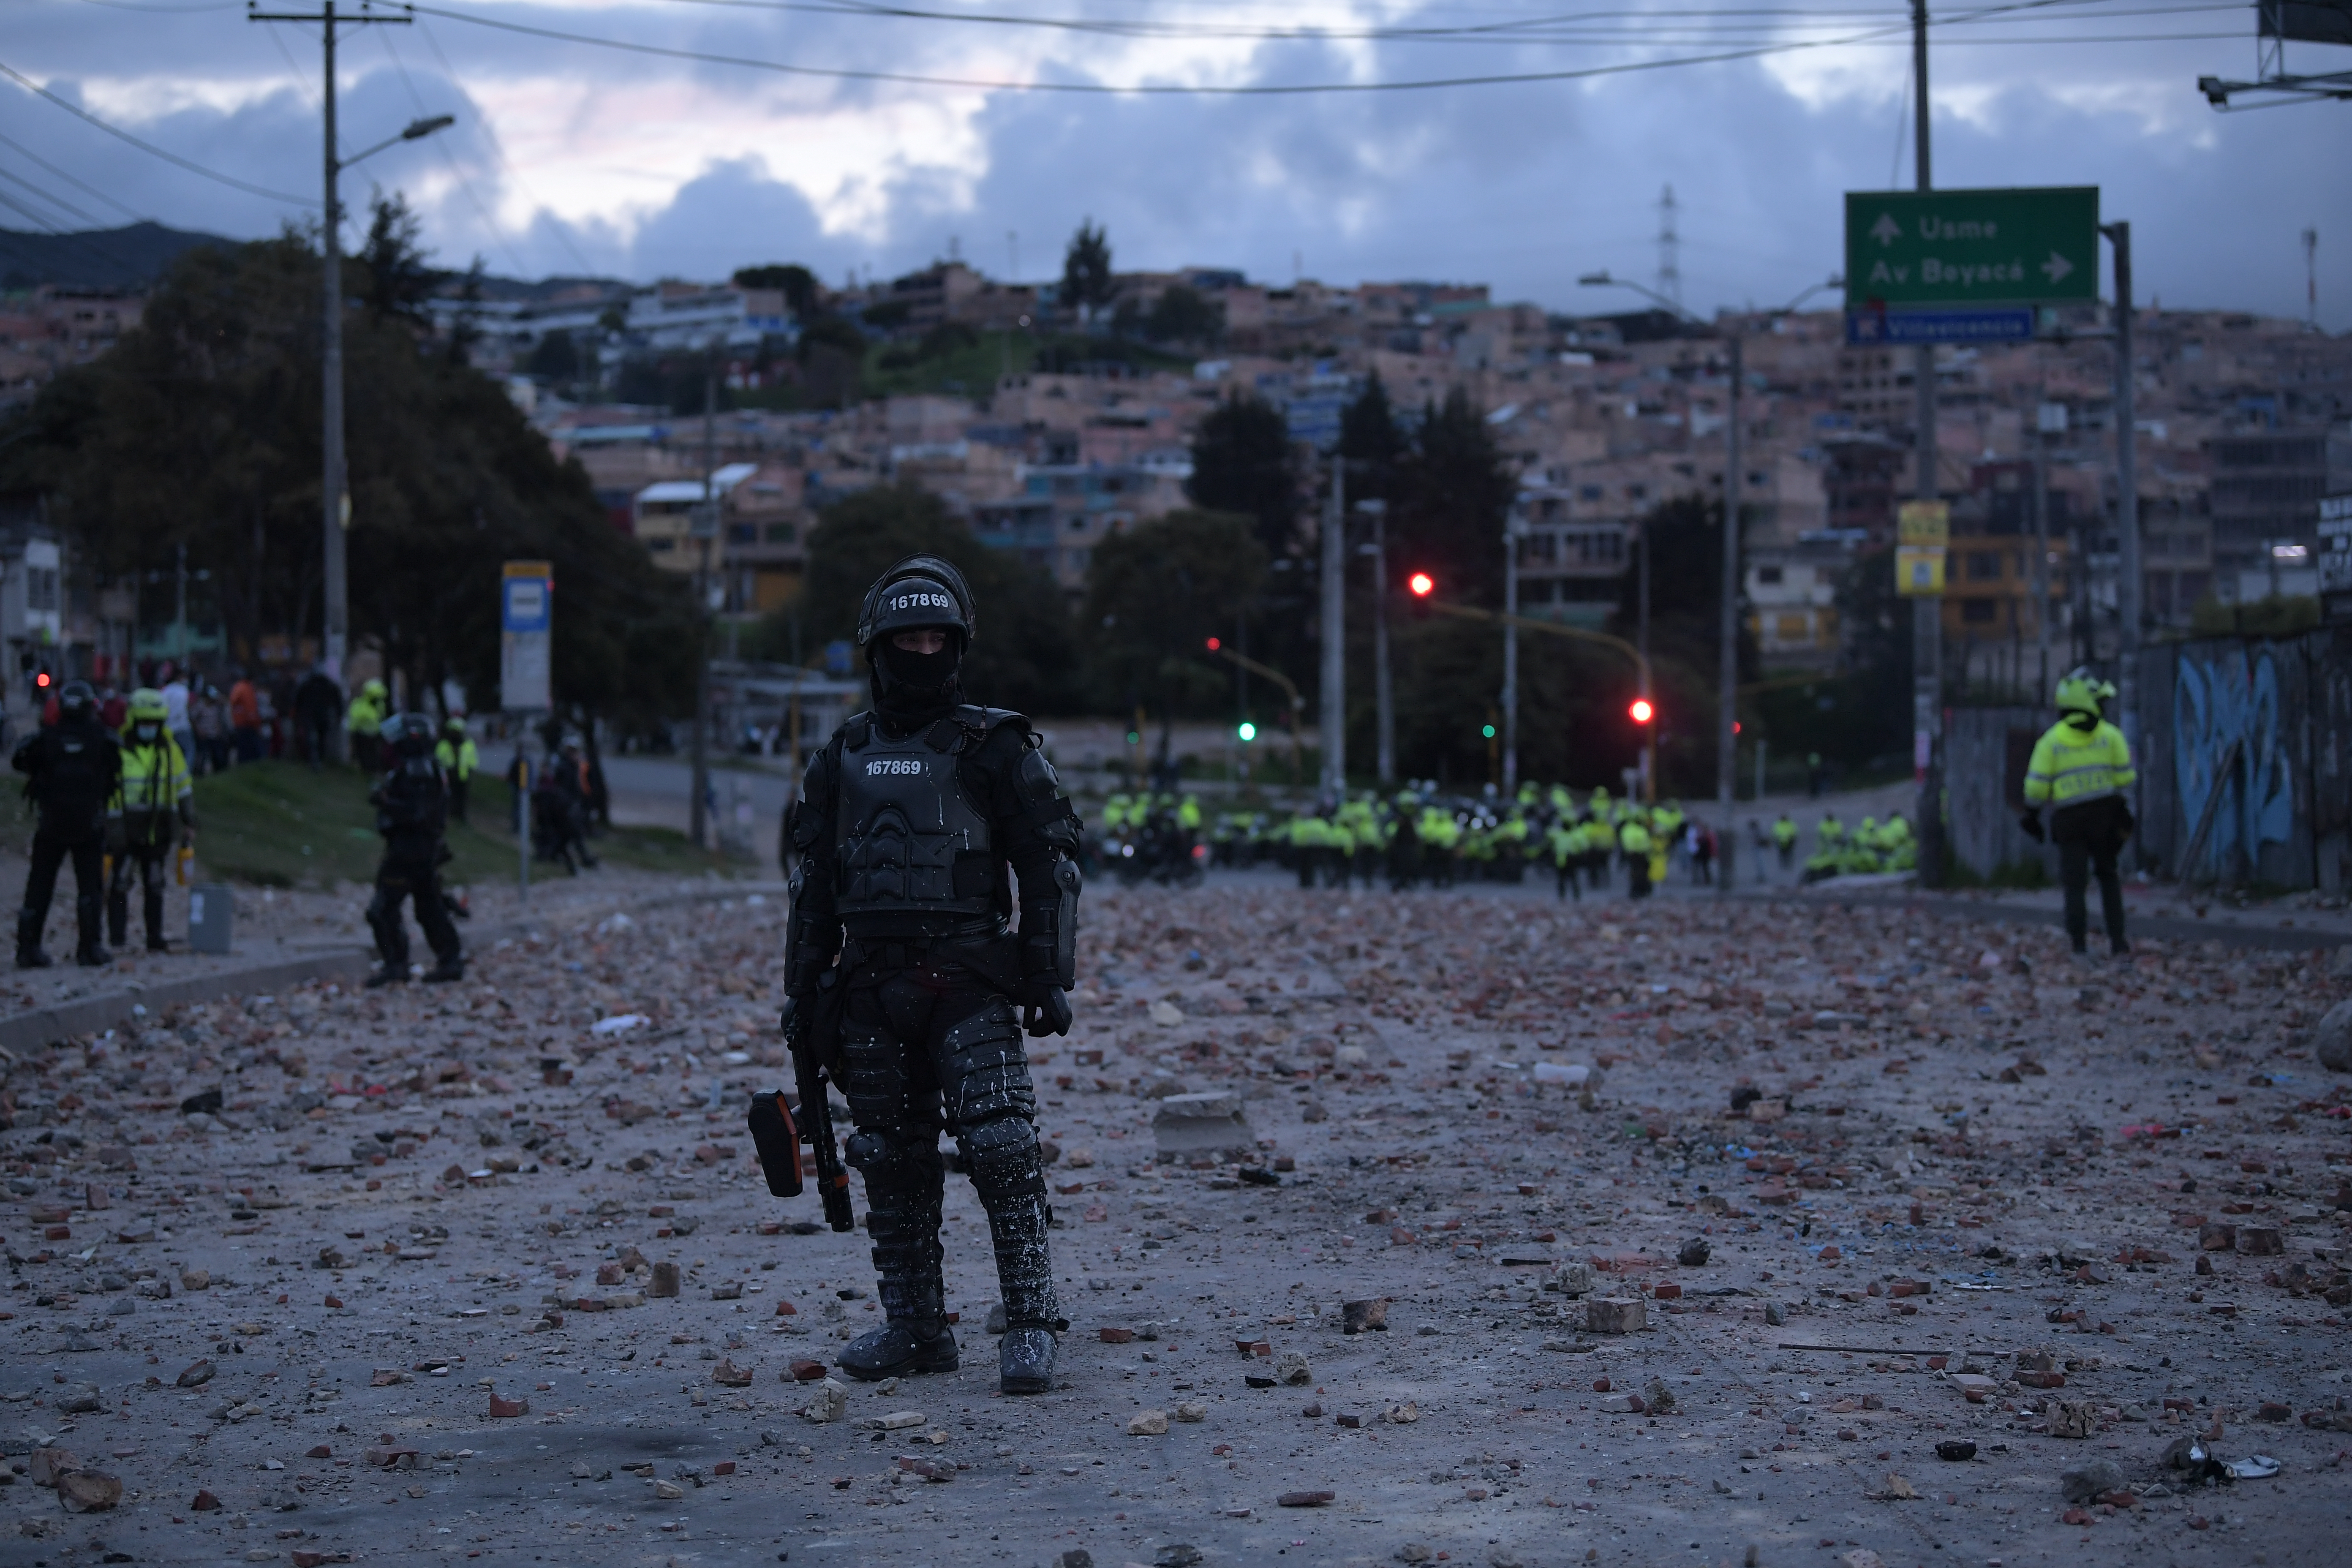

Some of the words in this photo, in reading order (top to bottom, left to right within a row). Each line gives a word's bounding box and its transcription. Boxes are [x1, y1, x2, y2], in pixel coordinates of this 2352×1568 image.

[1919, 215, 1997, 240] Usme
[1869, 260, 1909, 284] Av
[1921, 257, 2024, 287] Boyacá
[890, 593, 949, 610] 167869
[866, 761, 921, 776] 167869
